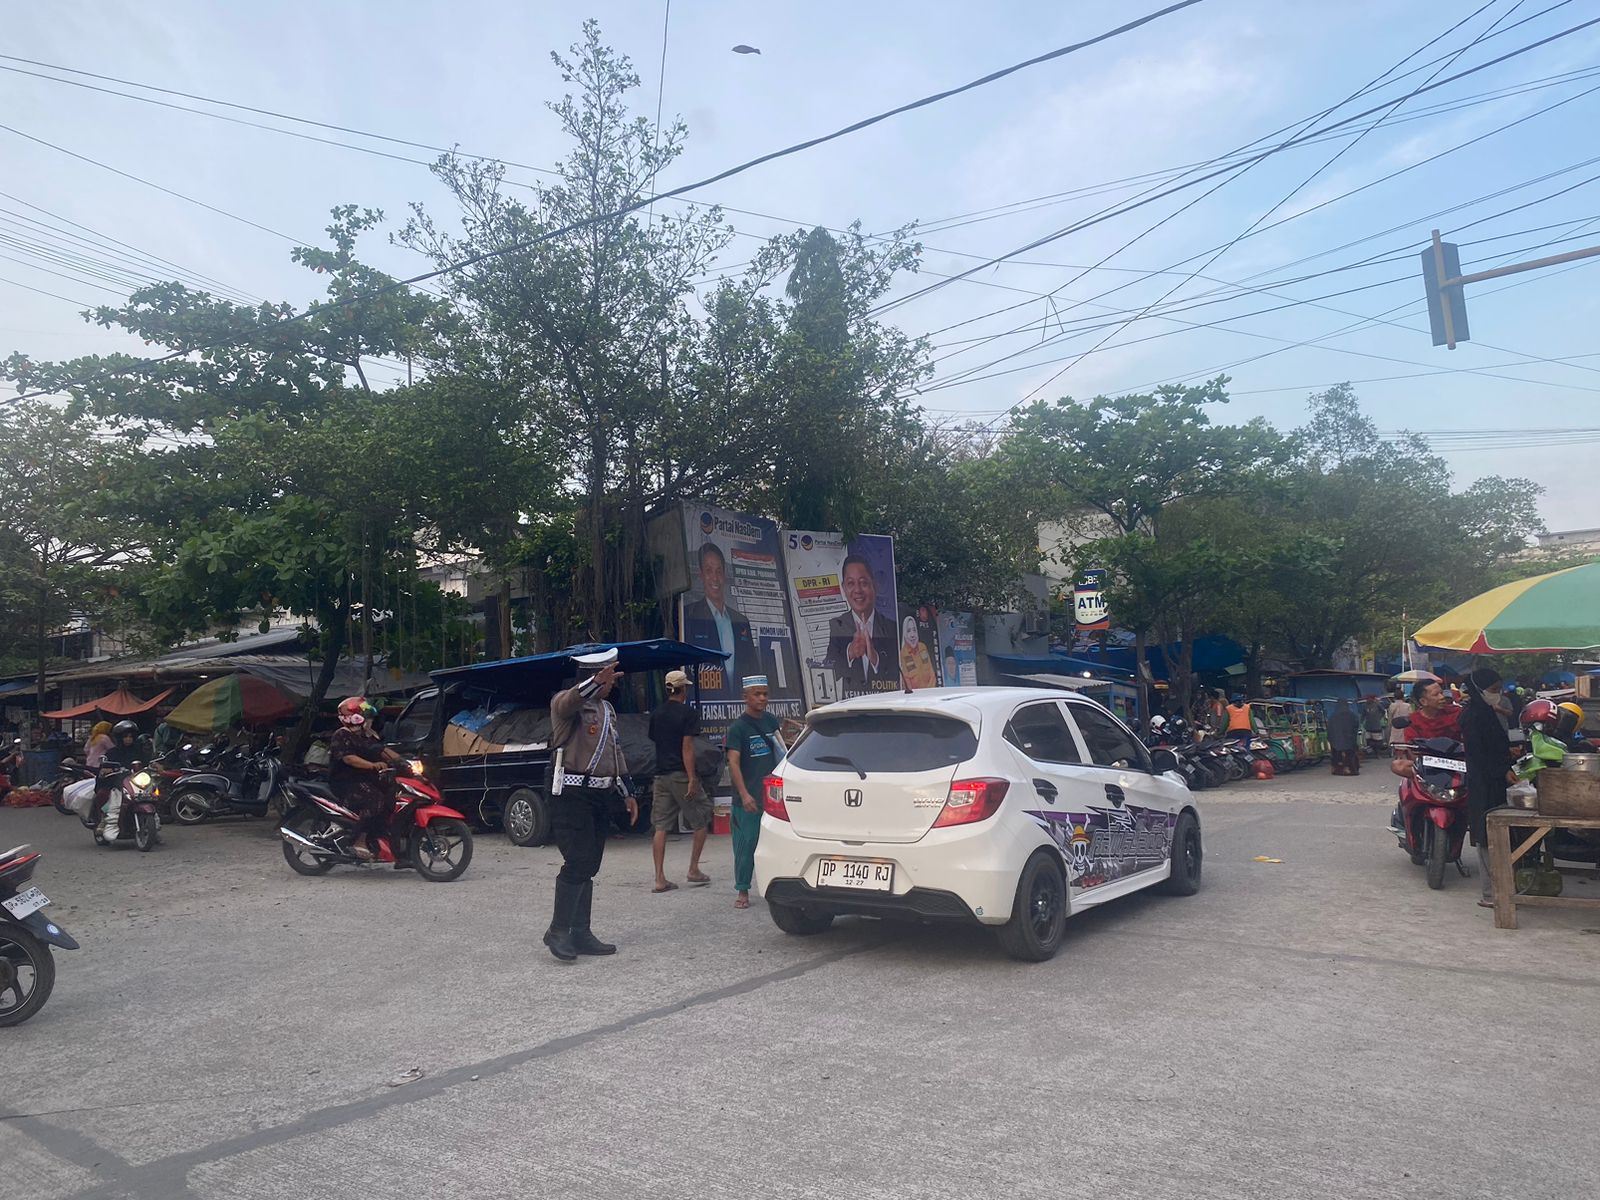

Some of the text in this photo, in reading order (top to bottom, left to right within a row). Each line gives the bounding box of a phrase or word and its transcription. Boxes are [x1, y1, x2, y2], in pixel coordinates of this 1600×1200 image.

[714, 516, 735, 534] Partai
[735, 521, 761, 538] NasDem
[789, 534, 798, 549] 5
[802, 579, 818, 587] DPR
[822, 576, 831, 586] RI
[1078, 596, 1105, 609] ATM
[760, 626, 789, 638] NOMOR URUT
[770, 641, 787, 689] 1
[817, 672, 831, 700] 1
[871, 680, 898, 690] POLITIK
[702, 704, 727, 721] FAISAL
[791, 702, 801, 717] SE
[822, 862, 890, 881] DP 1140 RJ
